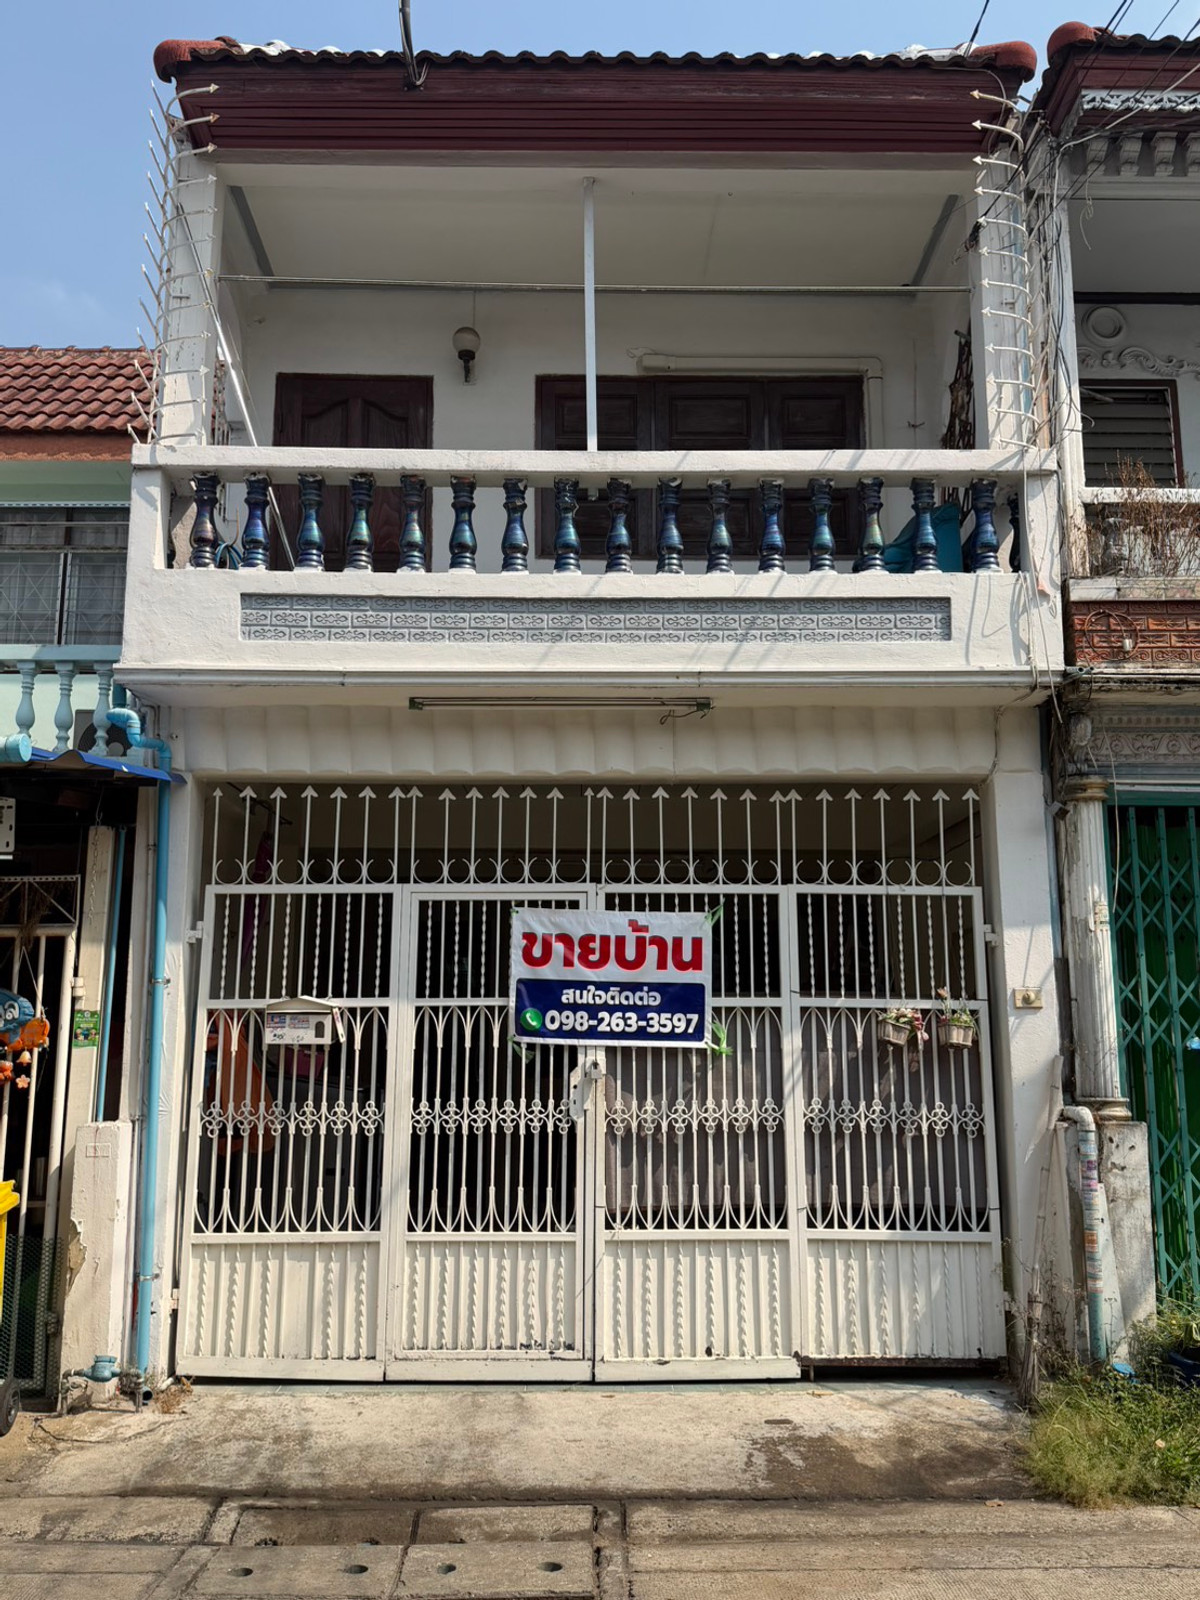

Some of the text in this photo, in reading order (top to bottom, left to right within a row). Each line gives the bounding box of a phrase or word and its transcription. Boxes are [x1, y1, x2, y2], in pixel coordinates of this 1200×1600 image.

[521, 919, 703, 972] ขายบ้าน
[561, 985, 662, 1006] สนใจติดต่อ
[545, 1009, 699, 1034] 098-263-3597
